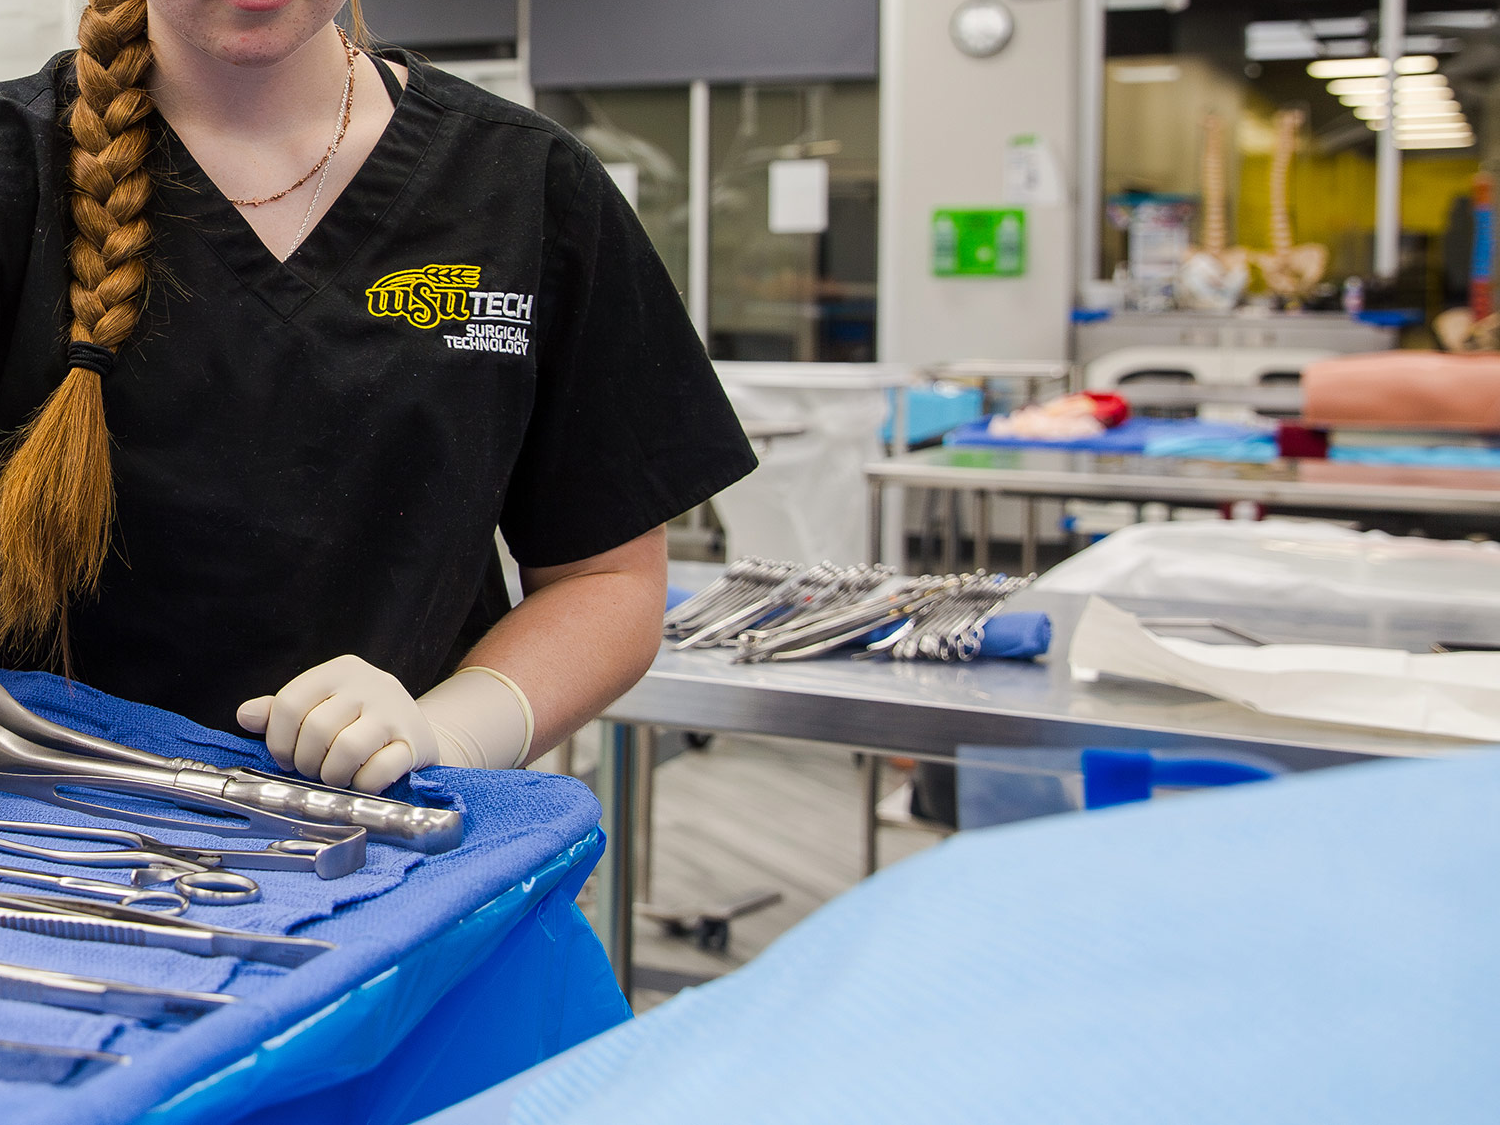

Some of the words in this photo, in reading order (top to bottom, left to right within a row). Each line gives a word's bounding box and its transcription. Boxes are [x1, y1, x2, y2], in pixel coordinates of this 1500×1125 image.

[469, 291, 534, 320] TECH
[466, 323, 530, 343] SURGICAL
[443, 334, 530, 356] TECHNOLOGY
